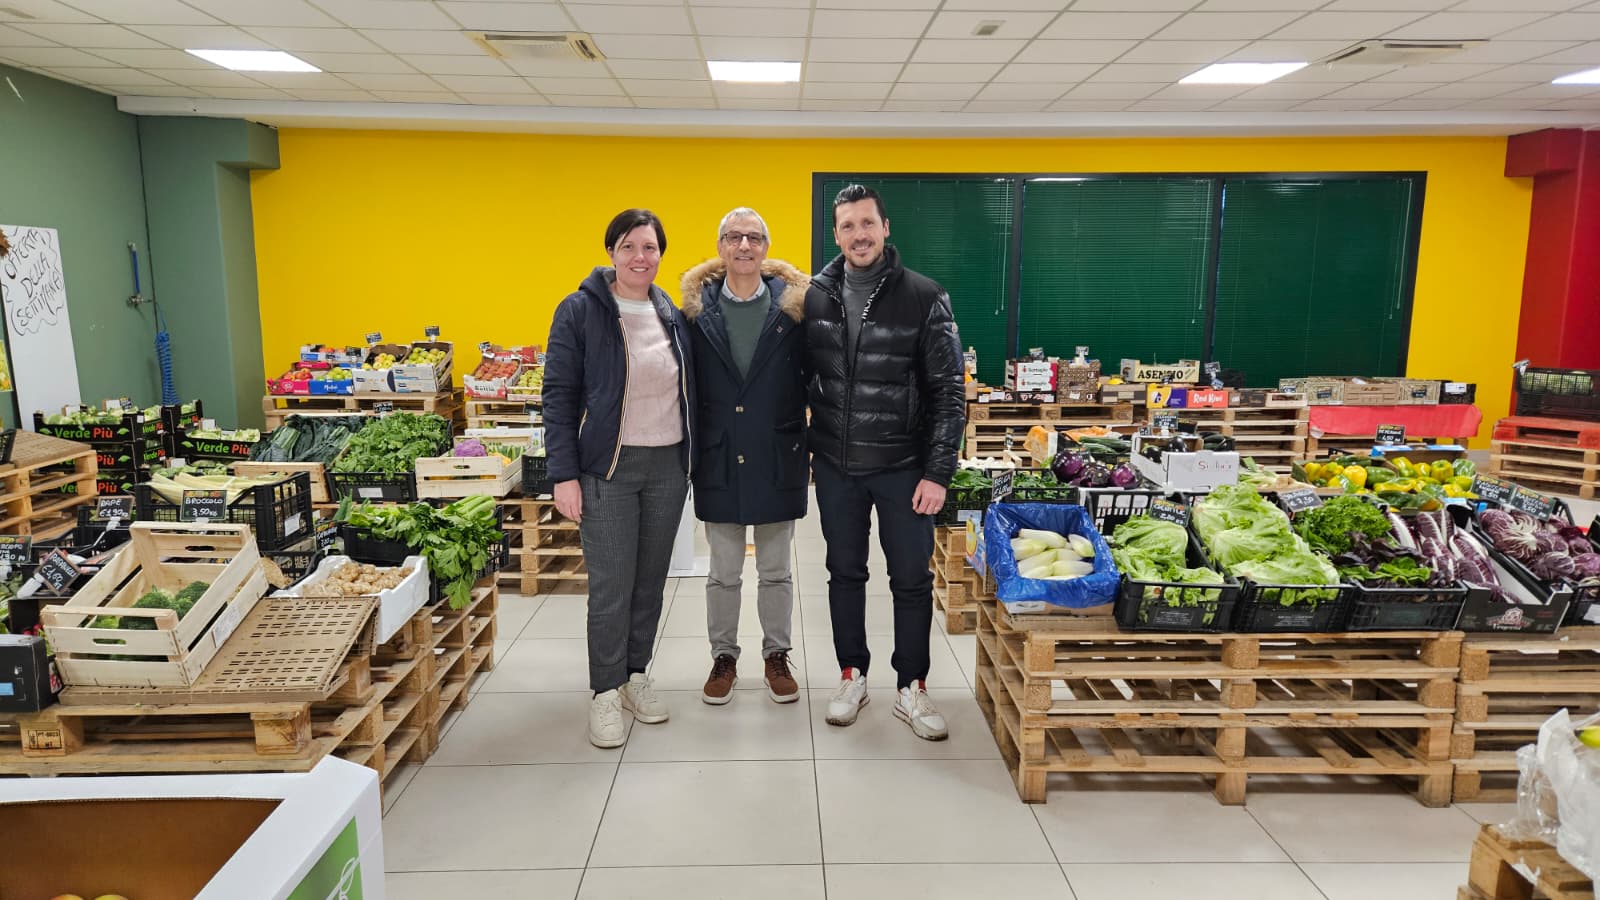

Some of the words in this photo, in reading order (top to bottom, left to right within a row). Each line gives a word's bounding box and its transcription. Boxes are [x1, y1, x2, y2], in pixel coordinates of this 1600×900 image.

[4, 229, 47, 280] OFFERTA
[20, 251, 51, 299] DELLA
[1193, 393, 1207, 403] Red
[54, 427, 91, 439] Verde
[93, 427, 113, 438] Più
[196, 441, 230, 453] Verde
[96, 455, 115, 465] Più
[97, 482, 117, 493] Più
